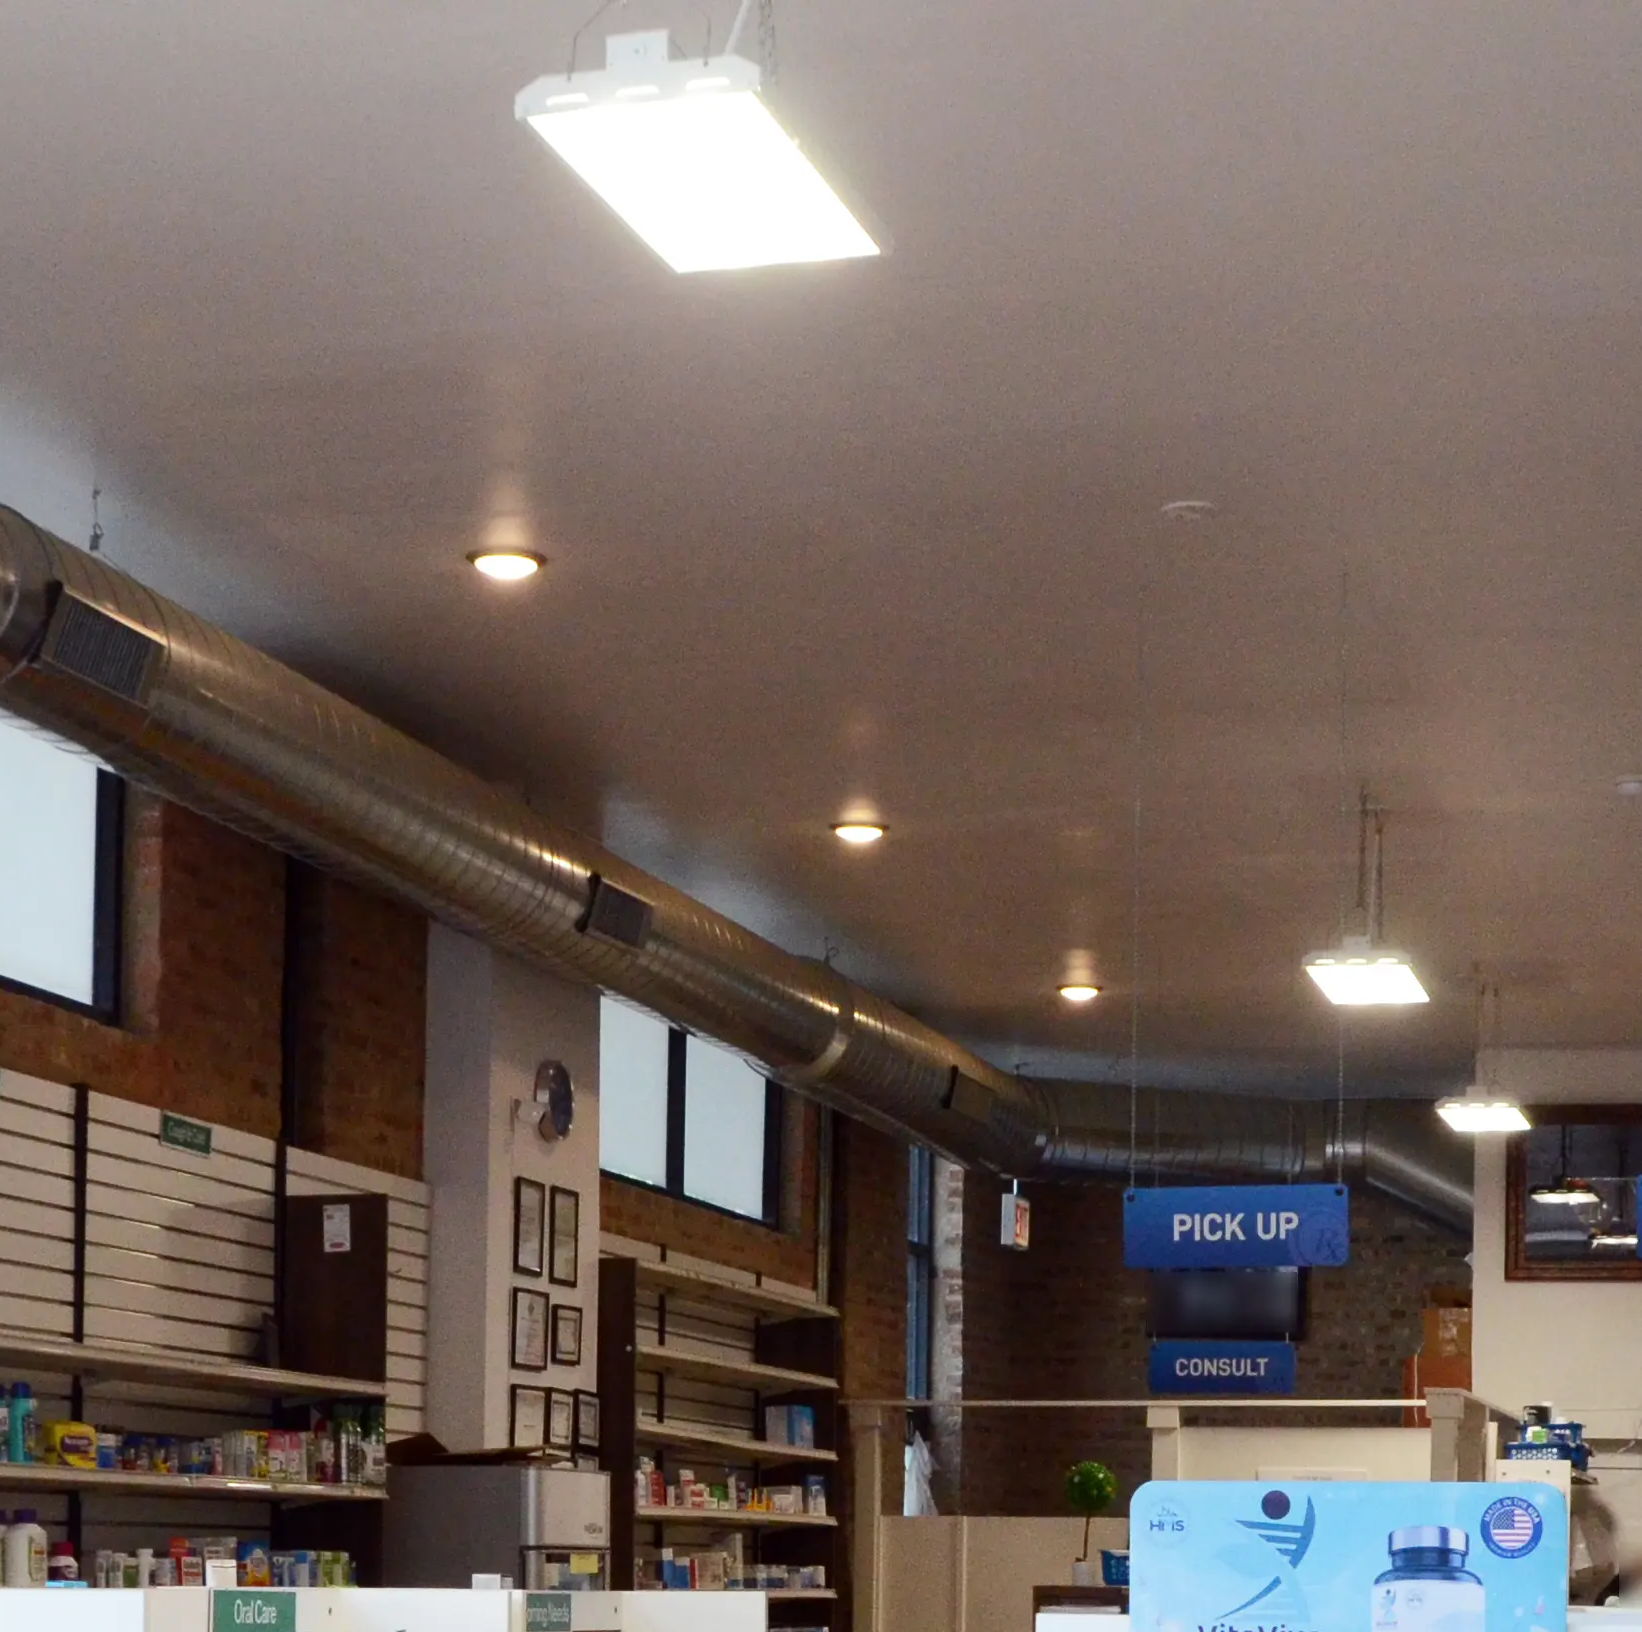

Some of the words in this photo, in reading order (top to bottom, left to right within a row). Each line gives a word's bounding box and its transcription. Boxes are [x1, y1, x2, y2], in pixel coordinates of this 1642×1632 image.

[1173, 1213, 1246, 1241] PICK
[1257, 1212, 1299, 1240] UP
[1175, 1358, 1269, 1377] CONSULT
[234, 1599, 255, 1624] Oral
[255, 1600, 278, 1625] Care
[547, 1604, 570, 1623] Needs
